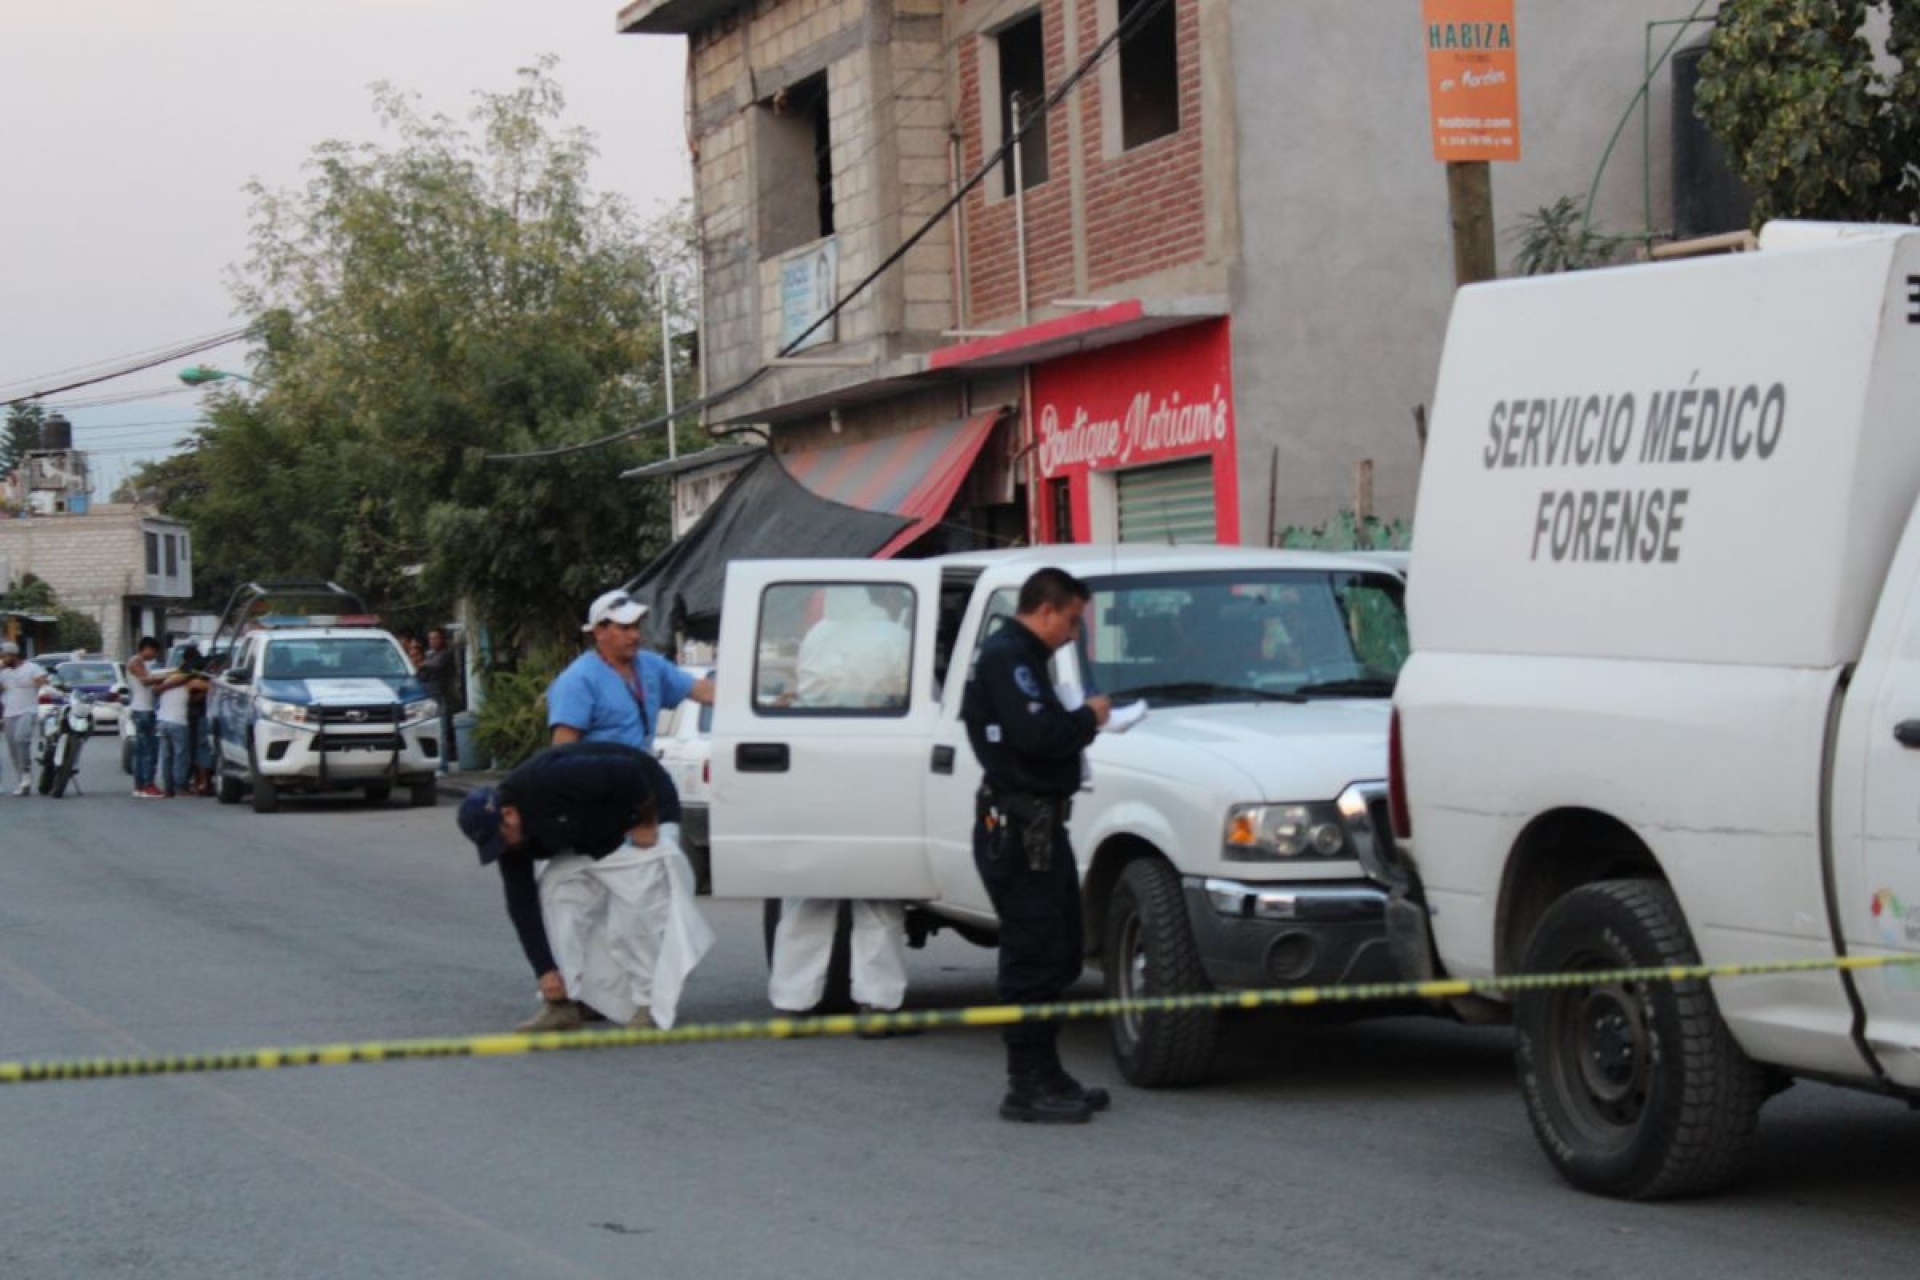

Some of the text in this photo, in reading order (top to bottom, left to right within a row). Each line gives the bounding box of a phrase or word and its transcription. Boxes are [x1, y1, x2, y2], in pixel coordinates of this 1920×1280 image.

[1429, 23, 1511, 48] HABIZA
[1039, 403, 1119, 477] Boutique
[1483, 368, 1787, 470] SERVICIO MÉDICO
[1530, 487, 1691, 563] FORENSE
